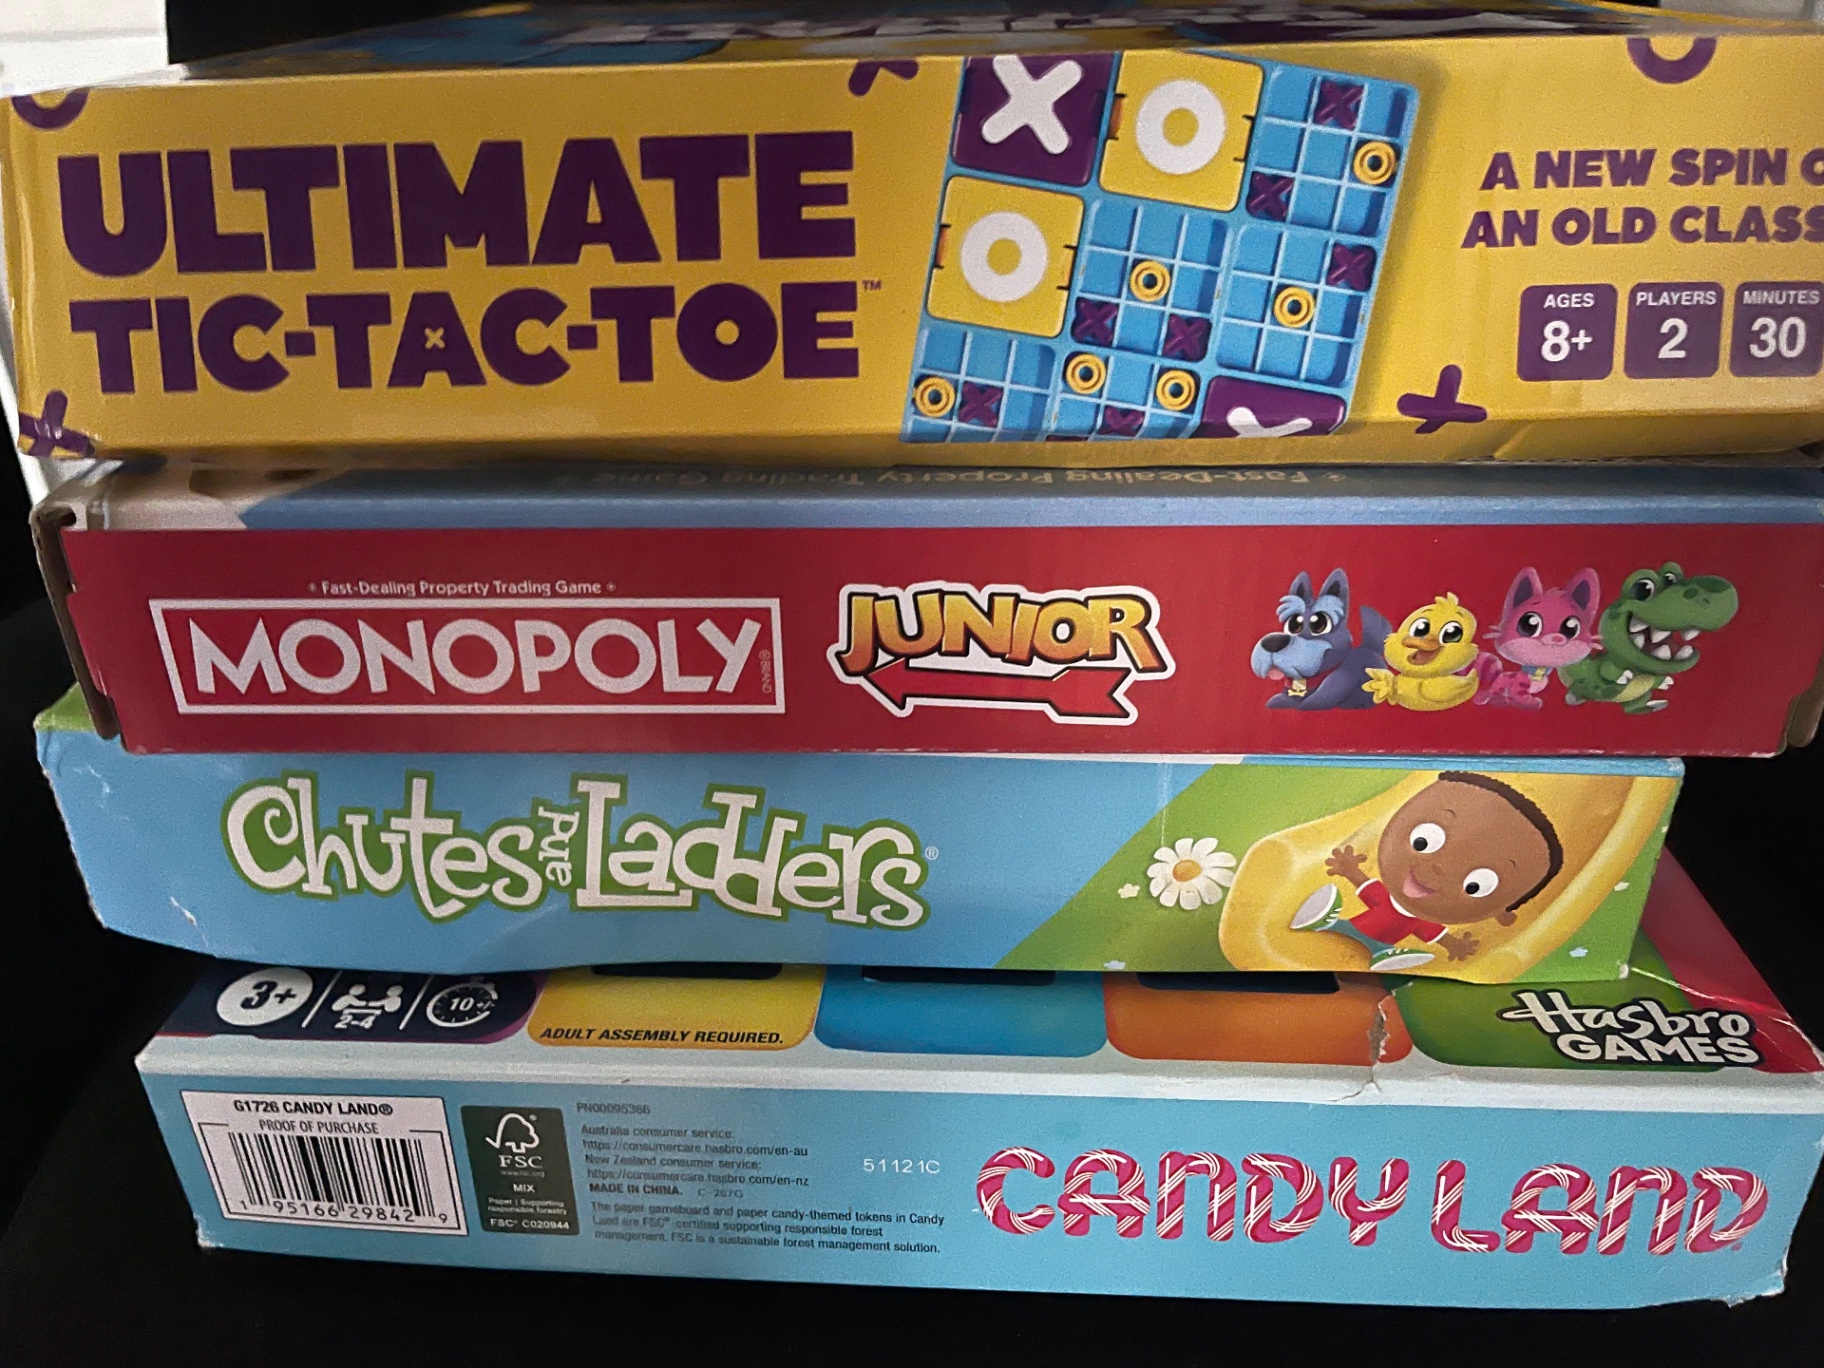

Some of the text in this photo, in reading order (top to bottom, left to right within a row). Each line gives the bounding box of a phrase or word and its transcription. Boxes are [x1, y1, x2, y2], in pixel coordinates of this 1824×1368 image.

[1480, 152, 1519, 190] A
[1534, 149, 1657, 188] NEW
[1668, 148, 1788, 187] SPIN
[58, 131, 857, 278] ULTIMATE
[1461, 209, 1538, 248] AN
[1552, 207, 1657, 246] OLD
[1543, 292, 1595, 308] AGES
[1635, 291, 1717, 307] PLAYERS
[1743, 290, 1820, 306] MINUTES
[1541, 320, 1593, 362] 8+
[1658, 318, 1688, 359] 2
[1749, 317, 1807, 358] 30
[321, 579, 602, 597] Fast-Dealing Property Trading Game
[837, 590, 1167, 675] JUNIOR
[189, 616, 762, 695] MONOPOLY
[227, 776, 542, 919] Chutes
[541, 806, 580, 888] and
[240, 980, 297, 1010] 3+
[450, 997, 475, 1011] 10
[335, 1013, 375, 1030] 2-4
[1502, 991, 1749, 1039] Hasbro
[540, 1028, 784, 1044] ADULT ASSEMBLY REQUIRED.
[1557, 1034, 1759, 1064] GAMES
[233, 1100, 279, 1113] G1726
[282, 1101, 333, 1115] CANDY
[259, 1119, 379, 1134] PROOF OF PURCHASE
[581, 1124, 629, 1137] Australia
[633, 1127, 688, 1138] consumer
[498, 1155, 543, 1169] FSC
[585, 1153, 609, 1165] New
[613, 1155, 656, 1166] Zealand
[660, 1158, 714, 1168] consumer
[513, 1184, 535, 1193] MIX
[589, 1183, 683, 1196] MADE IN CHINA.
[240, 1200, 448, 1224] 1 95166 29842 9
[976, 1146, 1768, 1256] CANDY LAND
[591, 1201, 945, 1226] The paper gameboard and paper candy-themed tokens in Candy
[592, 1215, 619, 1226] Land
[621, 1218, 639, 1227] are
[675, 1219, 719, 1230] certified
[723, 1220, 781, 1235] supporting
[785, 1224, 848, 1236] responsible
[851, 1226, 883, 1237] forest
[671, 1232, 692, 1243] FSC
[696, 1233, 705, 1244] is
[708, 1235, 715, 1244] a
[718, 1235, 780, 1247] sustainable
[784, 1237, 814, 1248] forest
[818, 1239, 890, 1251] management
[893, 1242, 941, 1253] solution.
